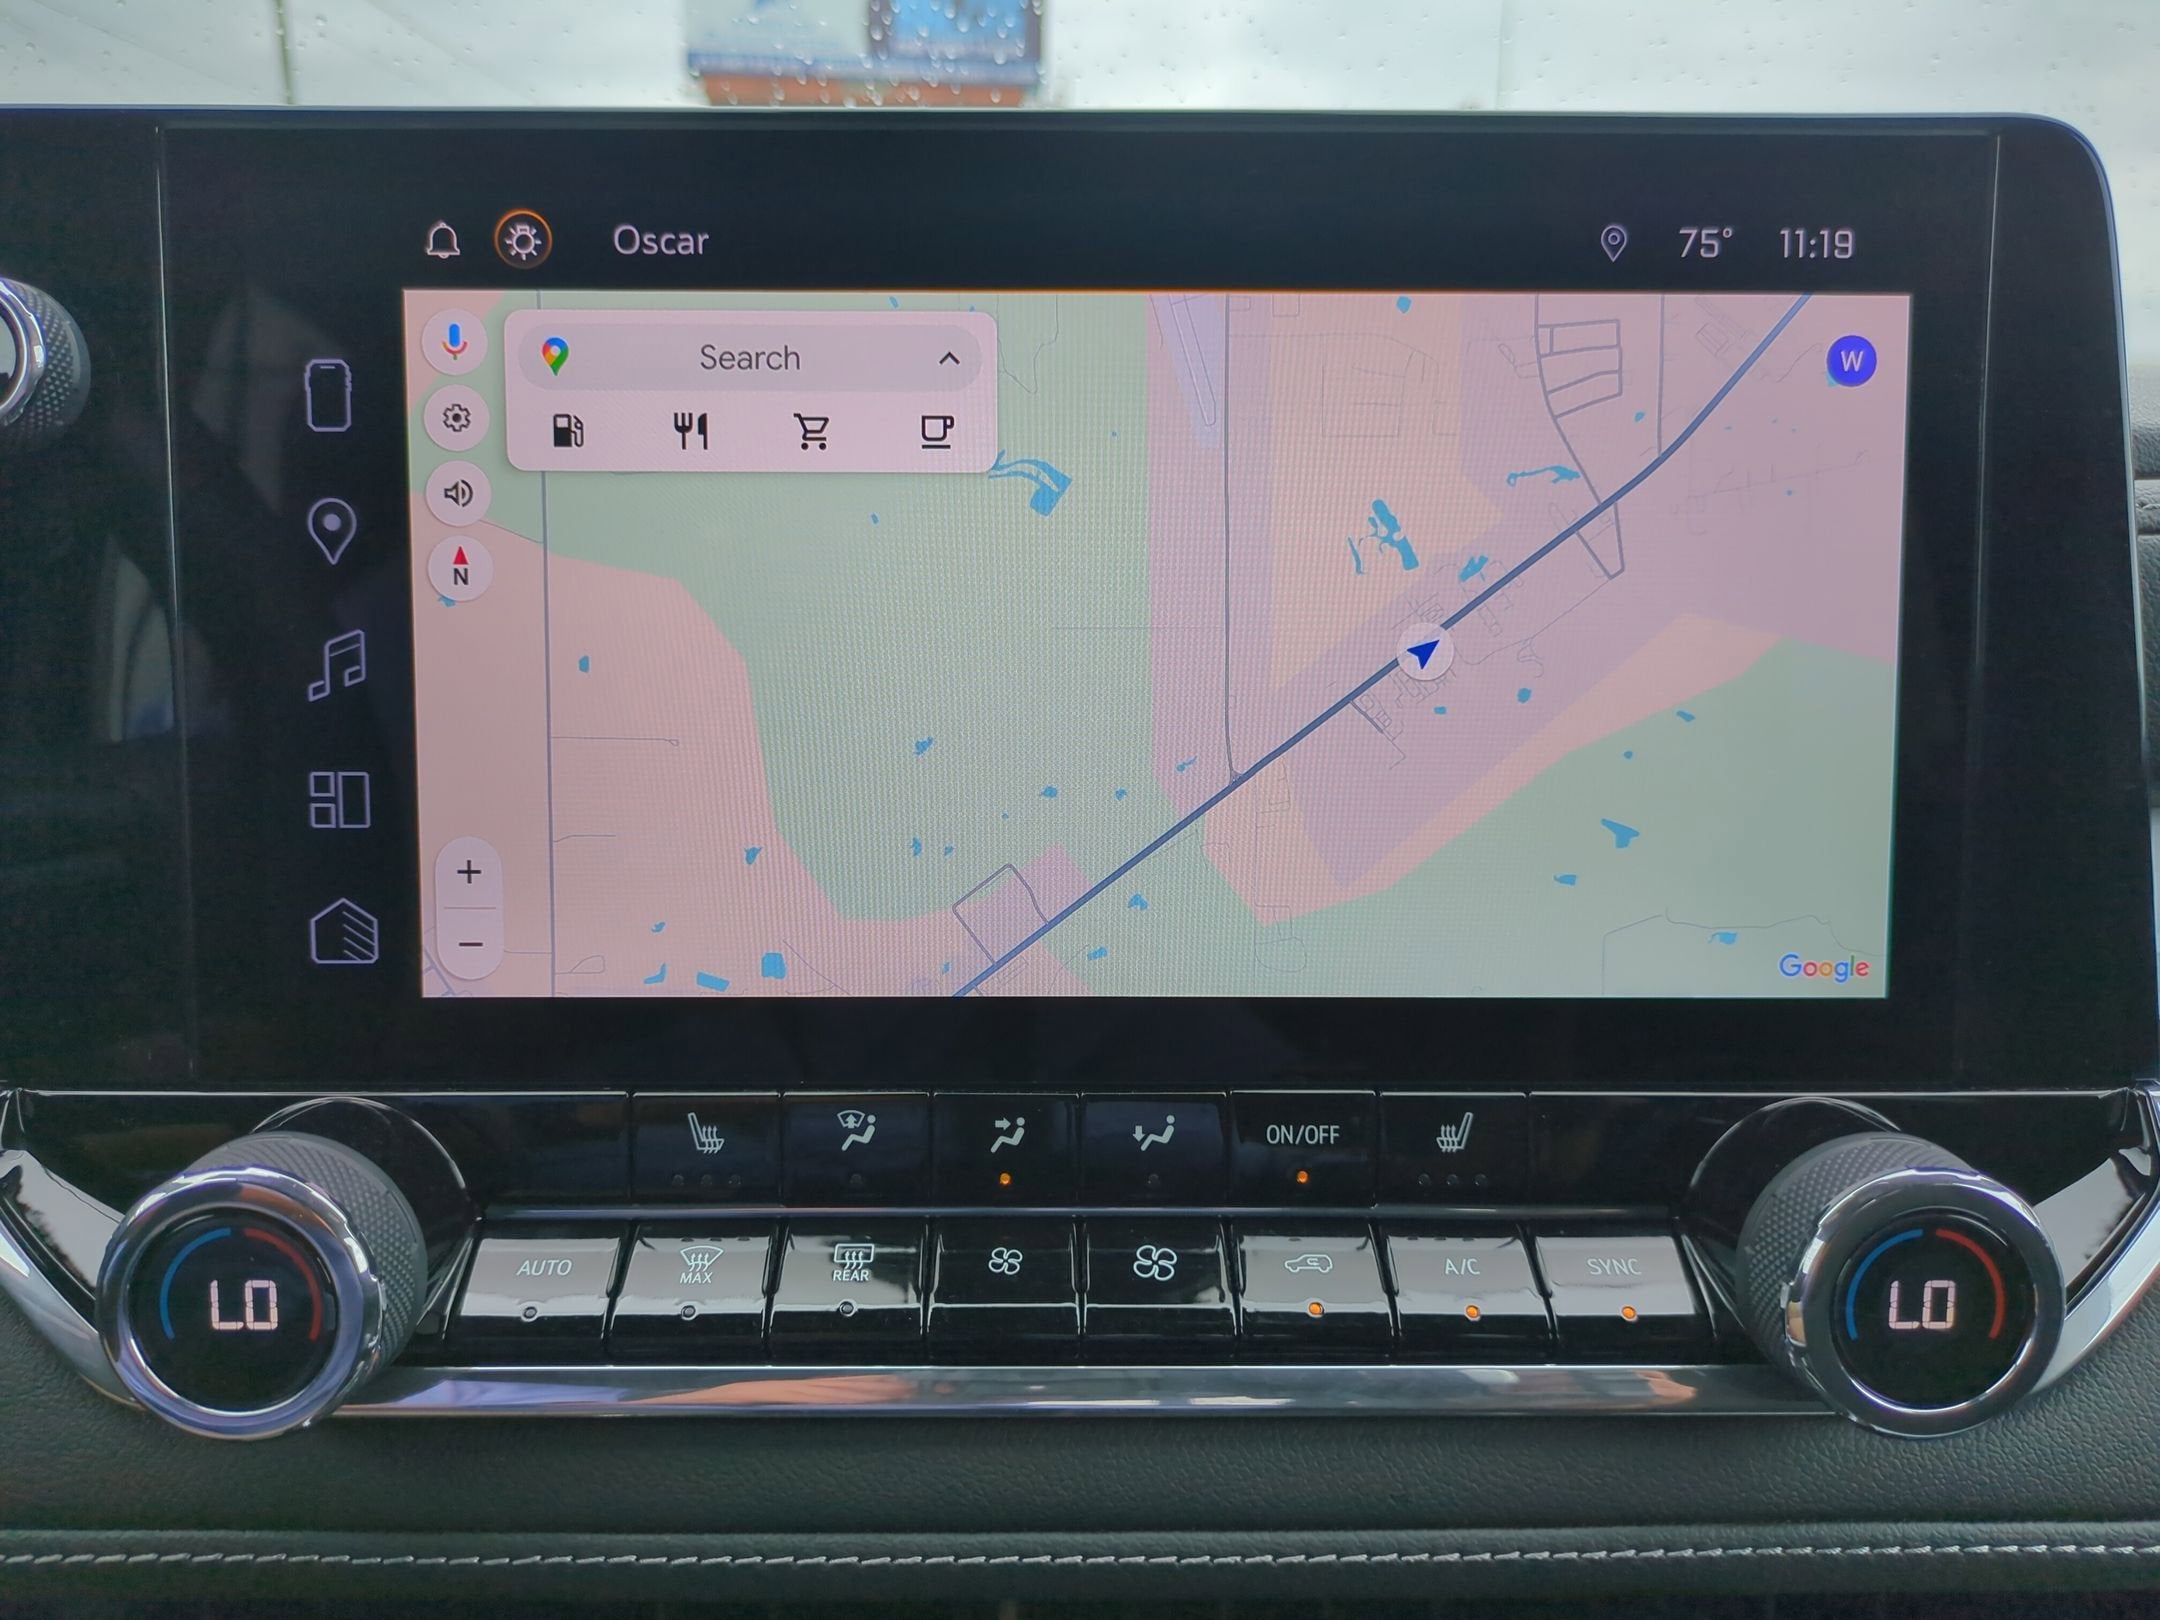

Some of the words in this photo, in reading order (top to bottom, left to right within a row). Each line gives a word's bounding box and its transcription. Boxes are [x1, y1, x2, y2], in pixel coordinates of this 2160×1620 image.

[613, 224, 710, 256] Oscar
[1779, 228, 1853, 259] 11:19
[700, 343, 801, 371] Search
[1840, 350, 1865, 373] W
[453, 567, 469, 586] N
[1779, 953, 1870, 983] Google
[1265, 1124, 1340, 1146] ON/OFF
[516, 1257, 573, 1277] AUTO
[832, 1268, 871, 1283] REAR
[1443, 1257, 1481, 1276] A/C
[1585, 1257, 1642, 1277] SYNC
[679, 1271, 713, 1285] MAX
[209, 1279, 279, 1331] LO
[1888, 1279, 1956, 1330] LO
